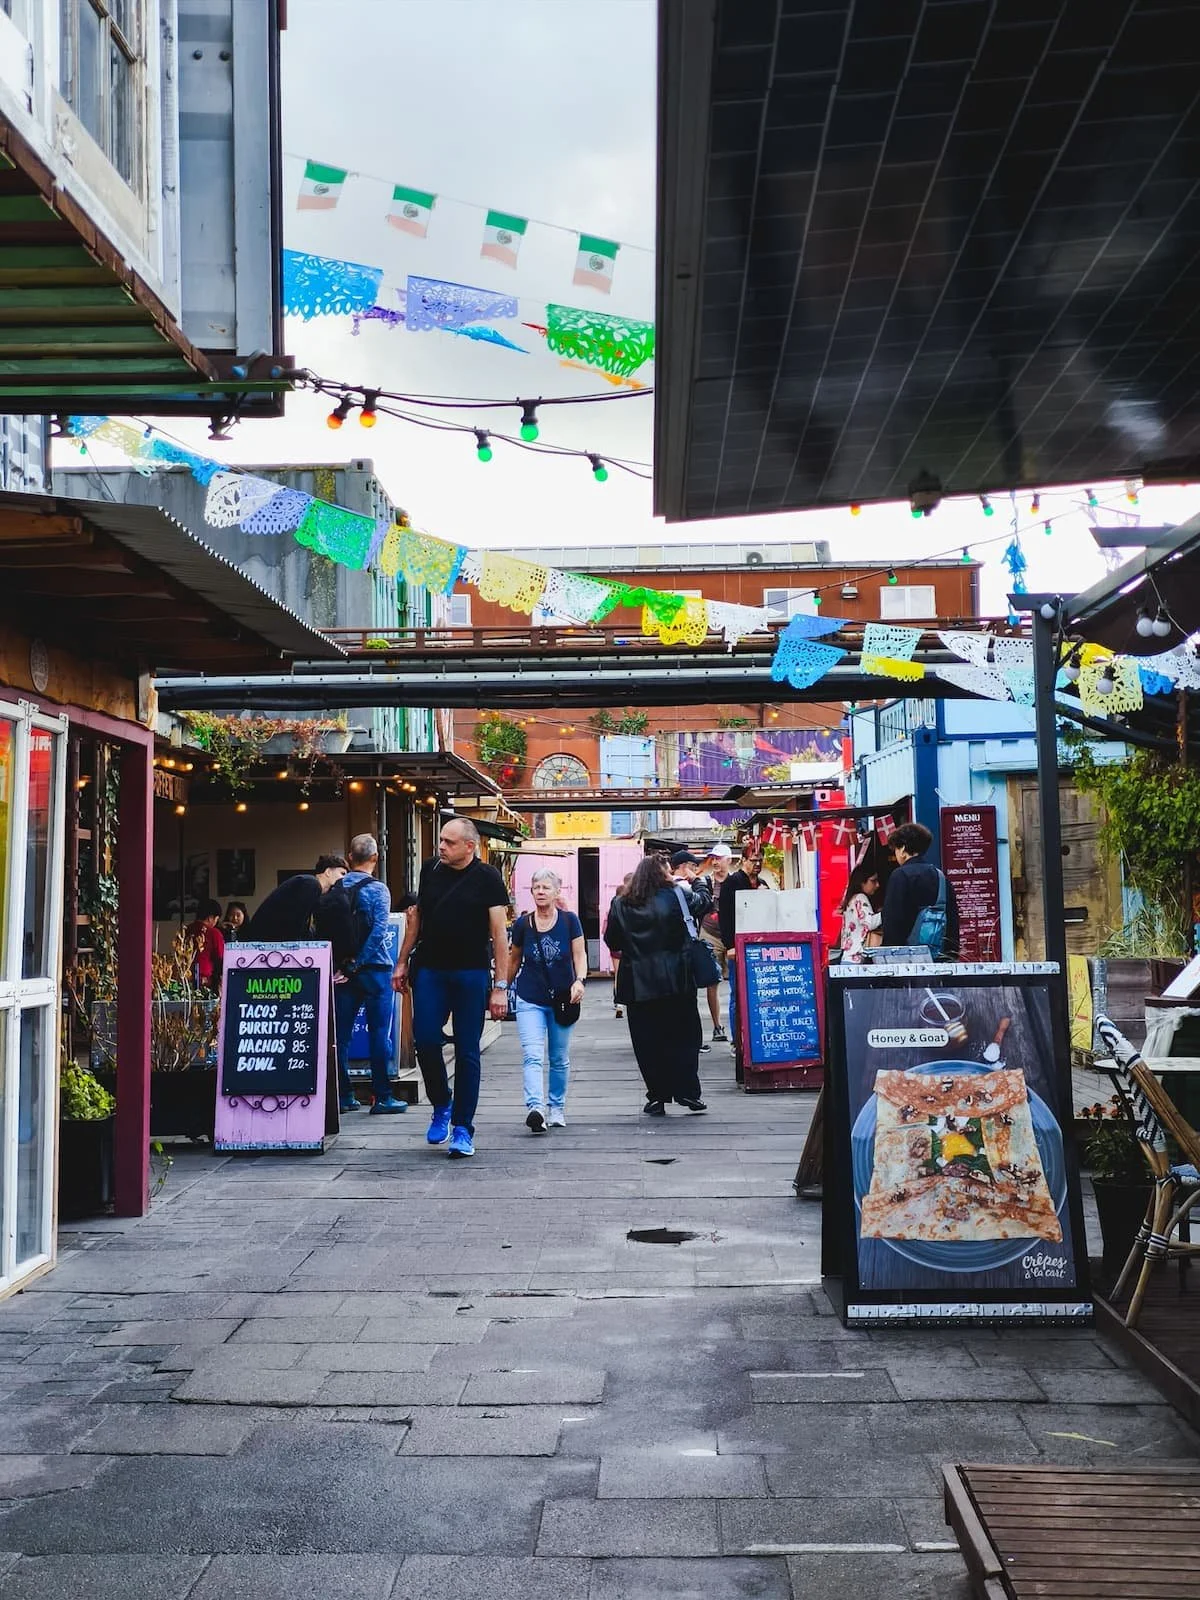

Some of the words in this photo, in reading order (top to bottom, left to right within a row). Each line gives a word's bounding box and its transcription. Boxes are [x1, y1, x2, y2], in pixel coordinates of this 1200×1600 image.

[954, 813, 981, 822] MENU
[761, 946, 803, 961] MENU
[246, 975, 302, 993] JALAPEÑO
[757, 988, 781, 997] FRANSK
[783, 987, 807, 995] HOTDOG
[238, 1003, 278, 1019] TACOS
[239, 1021, 290, 1035] BURRITO
[871, 1034, 907, 1044] Honey
[909, 1033, 917, 1042] &
[919, 1033, 945, 1042] Goat
[238, 1039, 286, 1054] NACHOS
[237, 1056, 276, 1072] BOWL
[1022, 1252, 1067, 1270] Crêpes
[1045, 1269, 1066, 1278] cart
